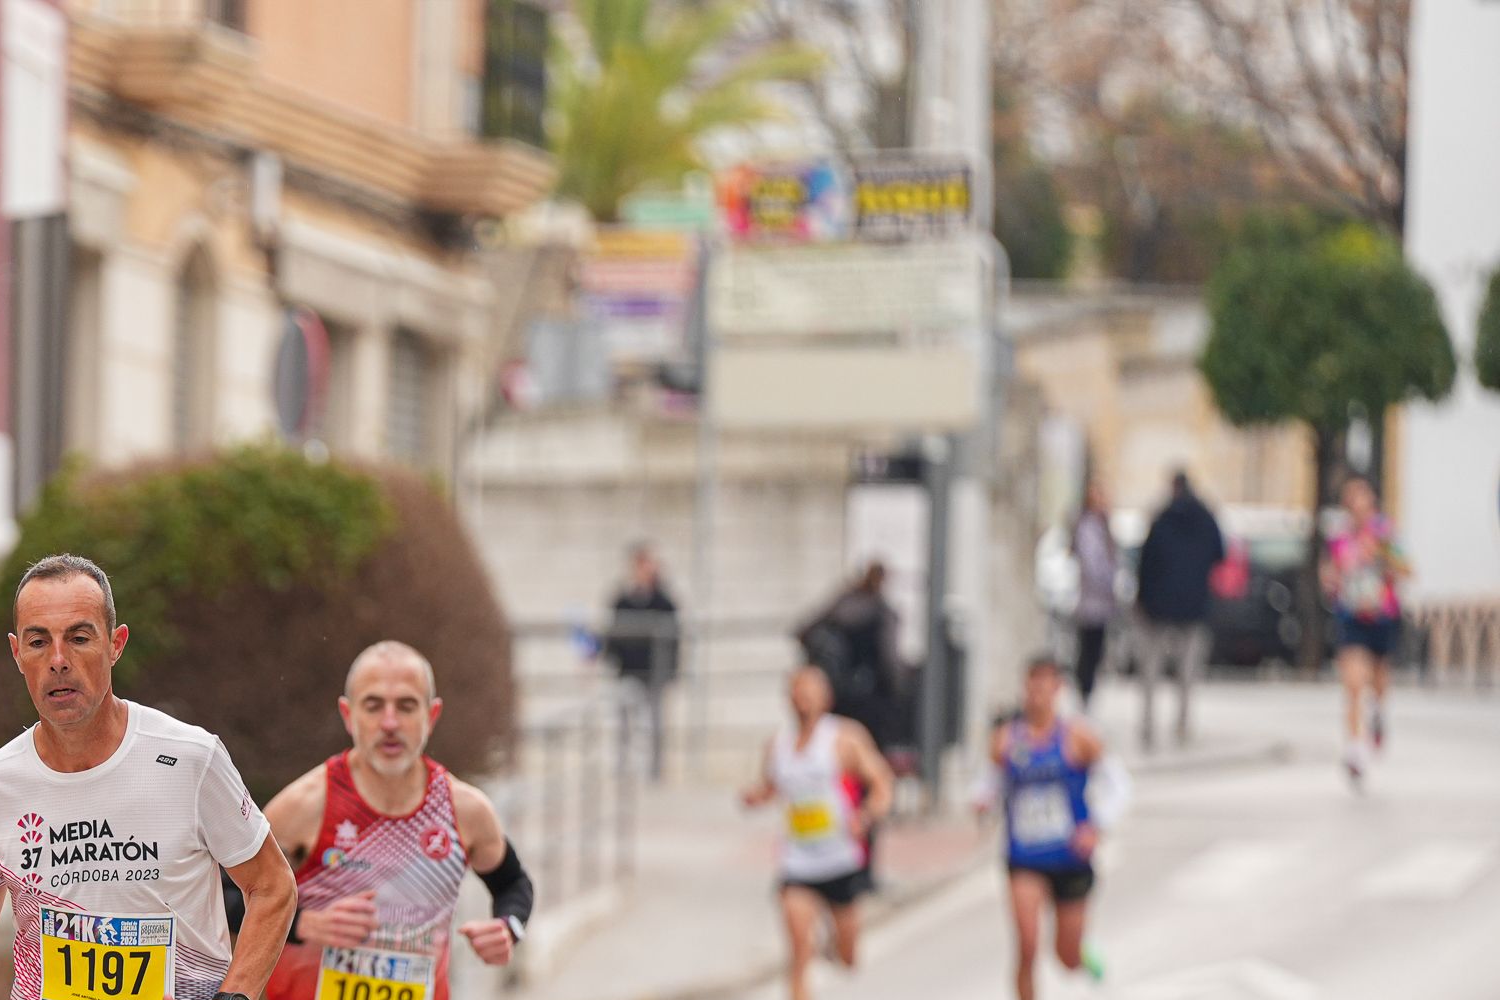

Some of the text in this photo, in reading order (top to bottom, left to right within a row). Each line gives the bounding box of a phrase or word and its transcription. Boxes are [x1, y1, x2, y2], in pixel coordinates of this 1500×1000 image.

[49, 819, 114, 844] MEDIA
[20, 847, 43, 869] 37
[51, 835, 158, 867] MARATÓN
[51, 869, 160, 887] CÓRDOBA 2023
[56, 913, 96, 943] 21K
[120, 936, 138, 946] 2026
[57, 944, 151, 996] 1197
